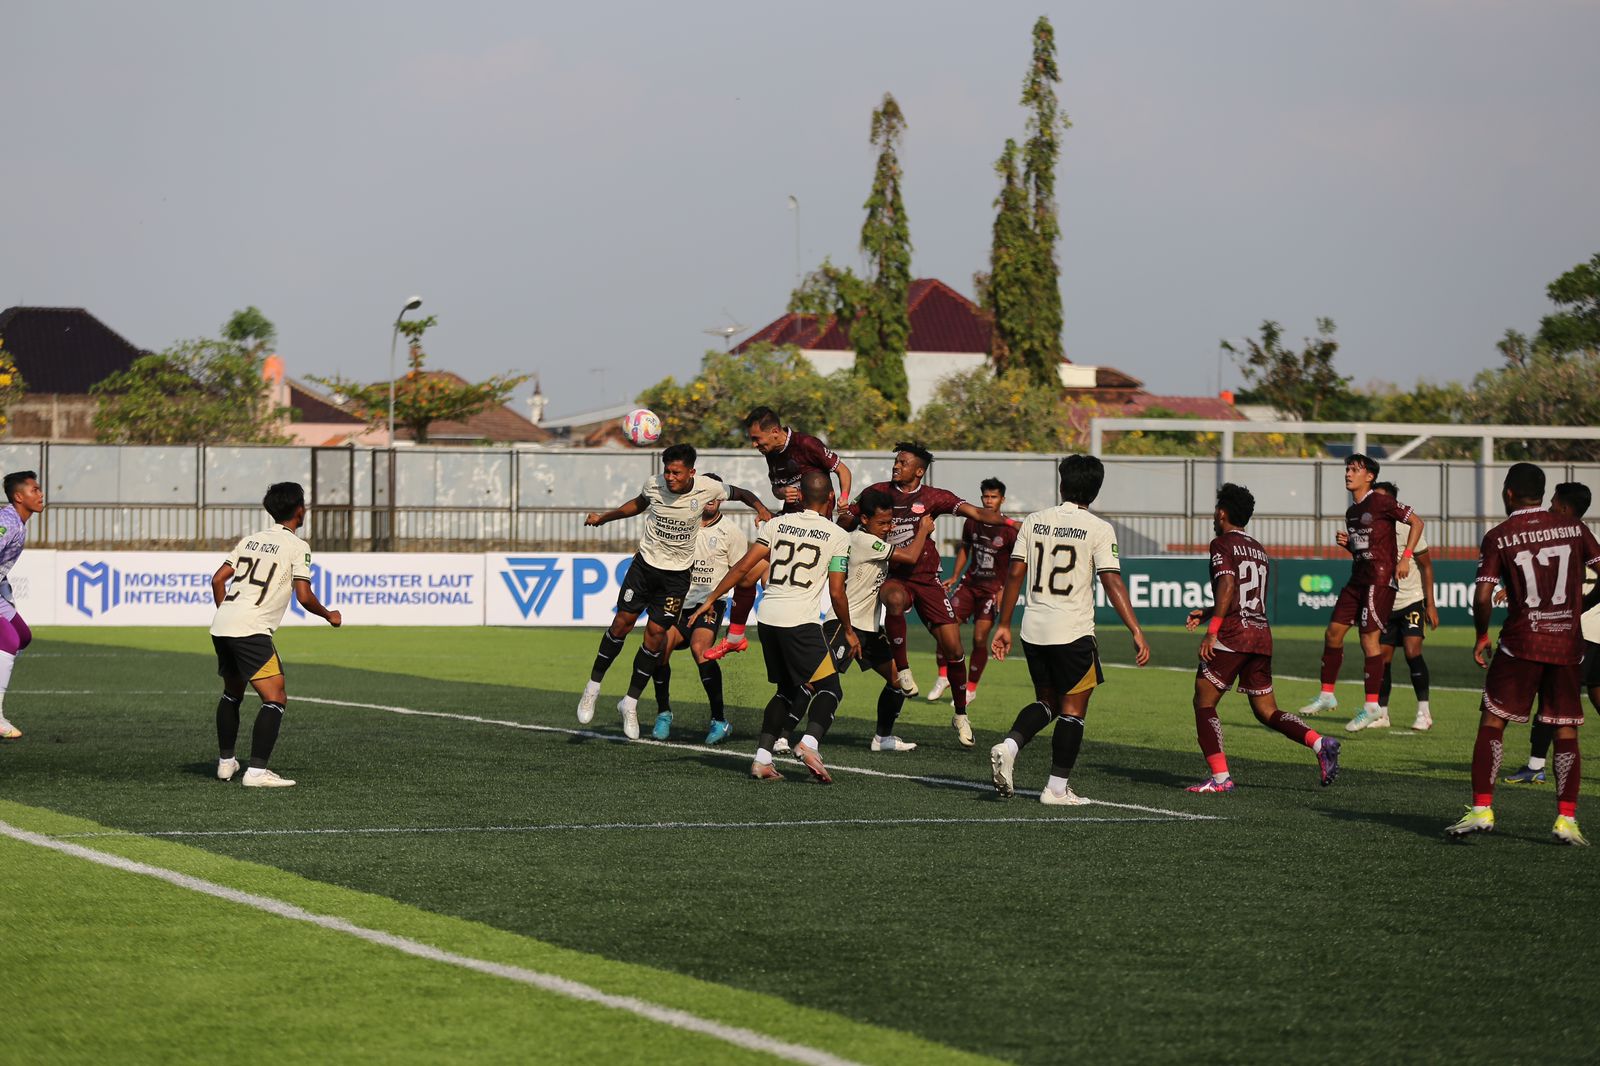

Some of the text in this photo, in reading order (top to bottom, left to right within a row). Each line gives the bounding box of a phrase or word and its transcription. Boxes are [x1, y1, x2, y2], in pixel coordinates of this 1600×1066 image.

[777, 523, 831, 542] SUPARDI NASIR
[245, 540, 260, 551] RIO
[769, 539, 821, 589] 22
[1032, 541, 1077, 596] 12
[125, 573, 212, 587] MONSTER
[224, 556, 278, 606] 24
[336, 574, 474, 587] MONSTER LAUT
[1513, 544, 1572, 608] 17
[1129, 574, 1215, 608] Emas
[1239, 560, 1267, 614] 21
[124, 591, 214, 604] INTERNAS
[336, 592, 473, 604] INTERNASIONAL
[943, 598, 953, 612] 9
